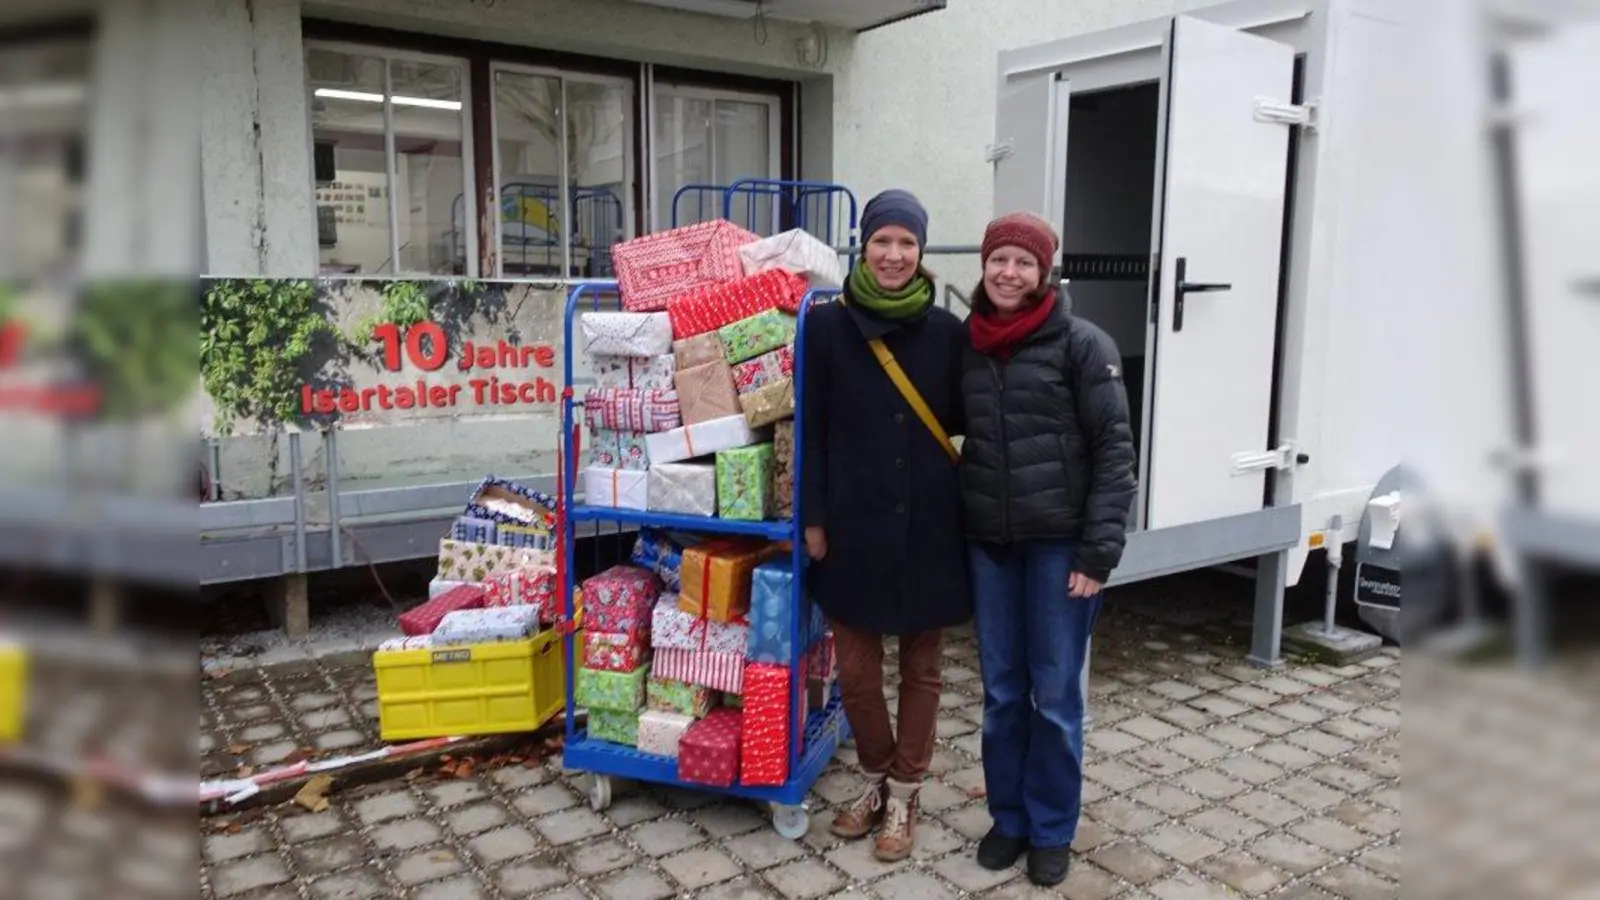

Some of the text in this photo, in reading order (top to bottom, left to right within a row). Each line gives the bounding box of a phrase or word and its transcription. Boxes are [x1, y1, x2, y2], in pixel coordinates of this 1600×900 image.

[373, 321, 555, 372] 10 Jahre
[300, 375, 556, 415] Isartaler Tisch
[433, 651, 470, 661] METRO
